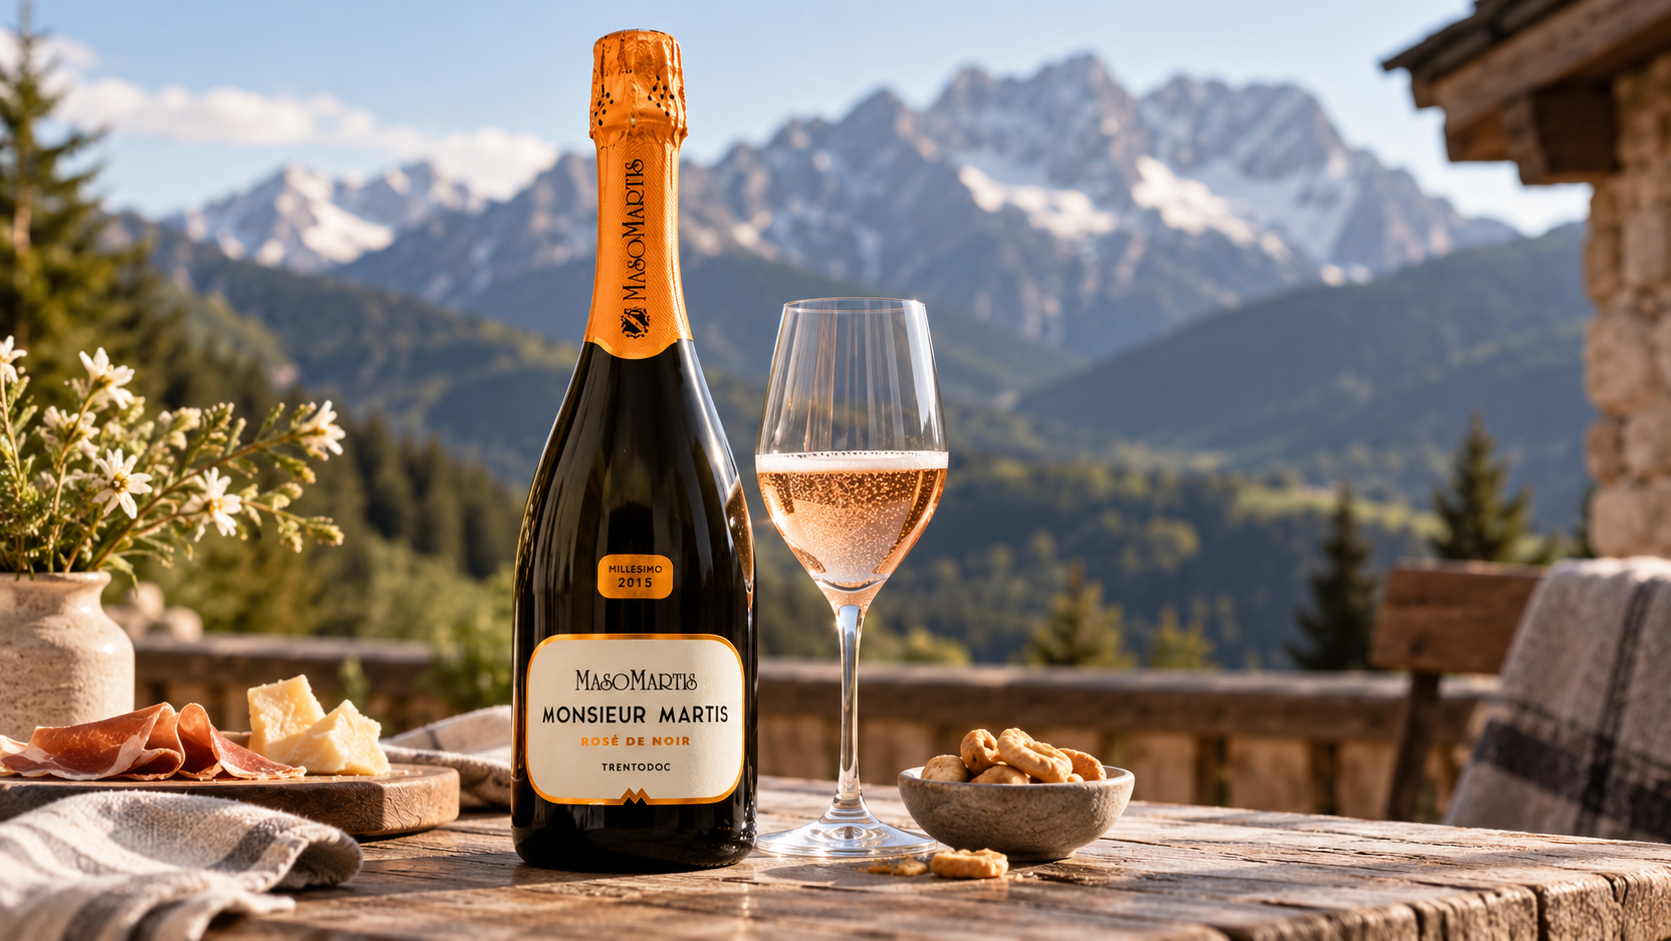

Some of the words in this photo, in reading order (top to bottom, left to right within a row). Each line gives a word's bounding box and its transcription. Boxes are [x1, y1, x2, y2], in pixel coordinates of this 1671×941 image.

[608, 565, 663, 574] MILLESIMO
[618, 577, 653, 588] 2015
[542, 705, 646, 724] MONSIEUR
[658, 705, 729, 723] MARTIS
[581, 734, 619, 747] ROSÉ
[626, 736, 646, 746] DE
[652, 736, 690, 746] NOIR
[602, 762, 671, 772] TRENTODOC
